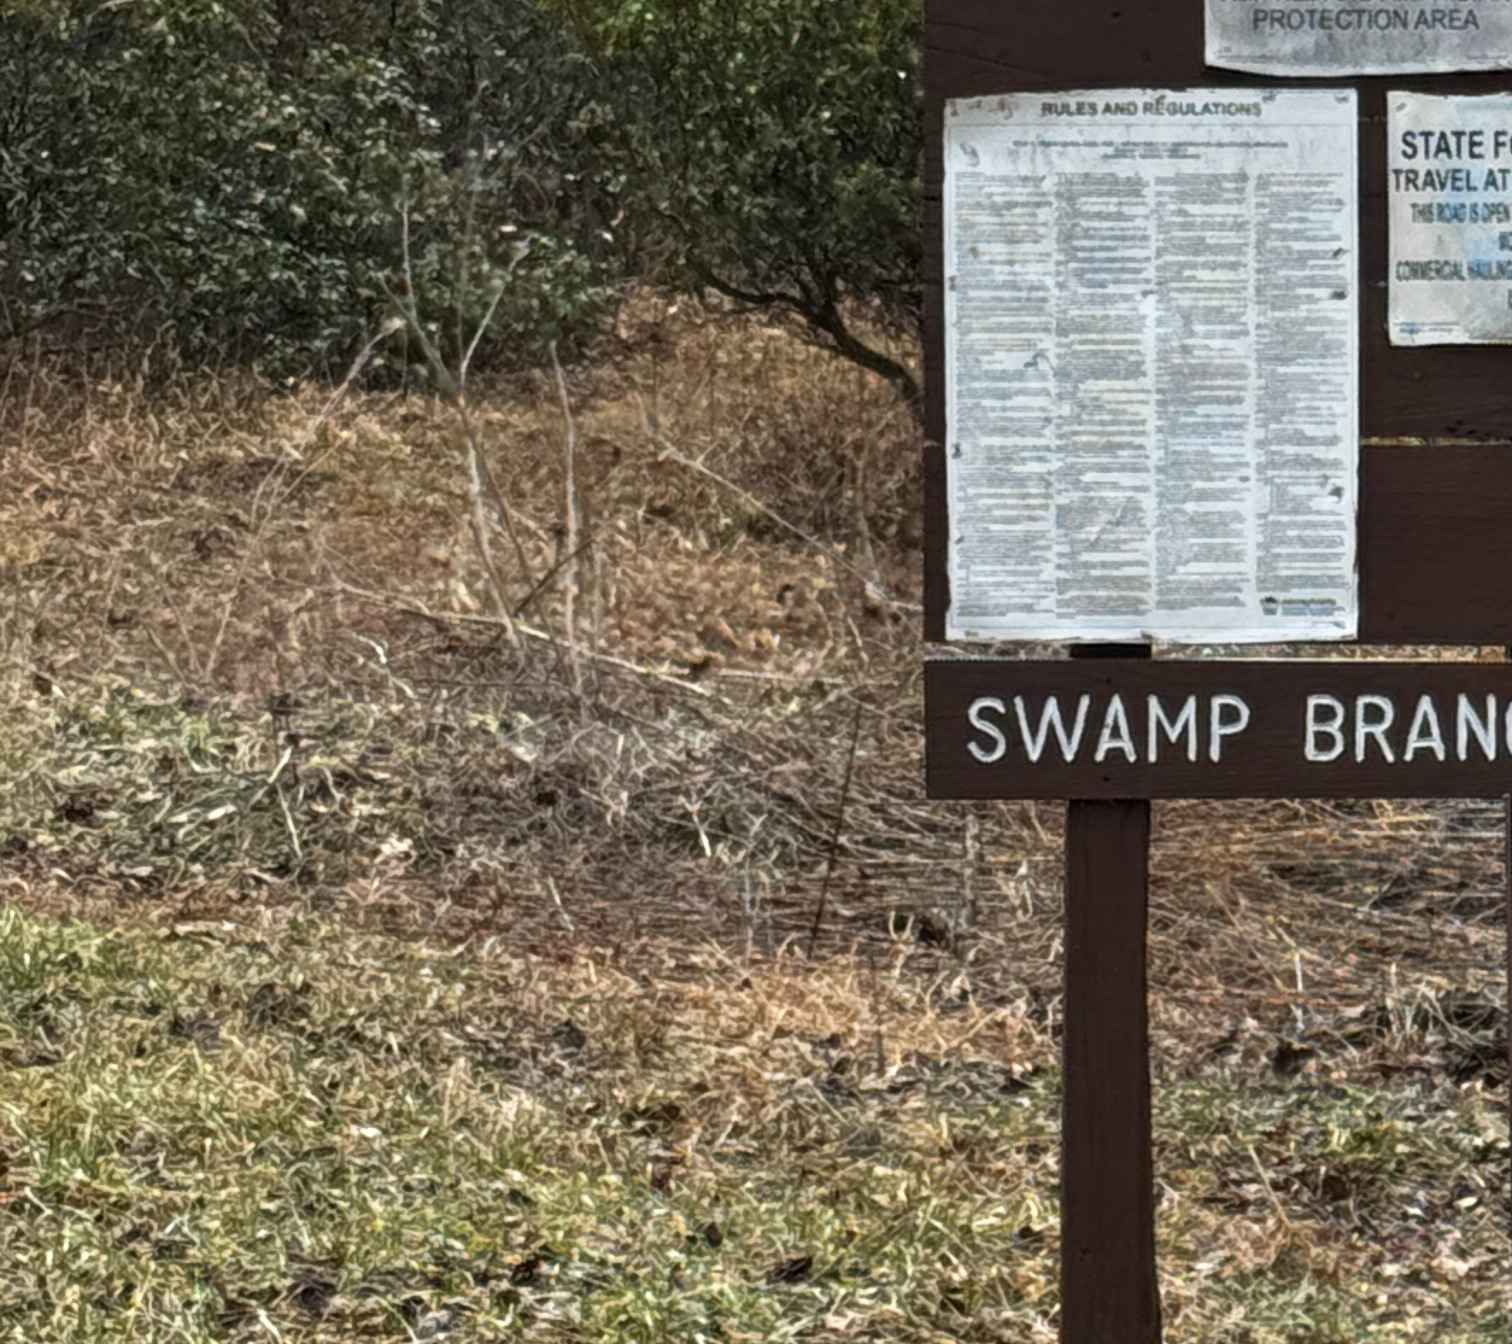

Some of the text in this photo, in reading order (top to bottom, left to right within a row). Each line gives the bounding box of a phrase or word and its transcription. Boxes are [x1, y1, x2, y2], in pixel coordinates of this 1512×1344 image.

[1252, 8, 1480, 31] PROTECTION AREA
[1040, 99, 1262, 118] RULES AND REGULATIONS
[1400, 130, 1485, 160] STATE
[1392, 168, 1478, 192] TRAVEL
[1483, 168, 1511, 191] AT
[1410, 202, 1434, 224] THIS
[1436, 202, 1466, 224] ROAD
[1468, 202, 1479, 224] IS
[1480, 202, 1511, 224] OPEN
[1395, 259, 1466, 281] COMMERCIAL
[966, 693, 1251, 764] SWAMP
